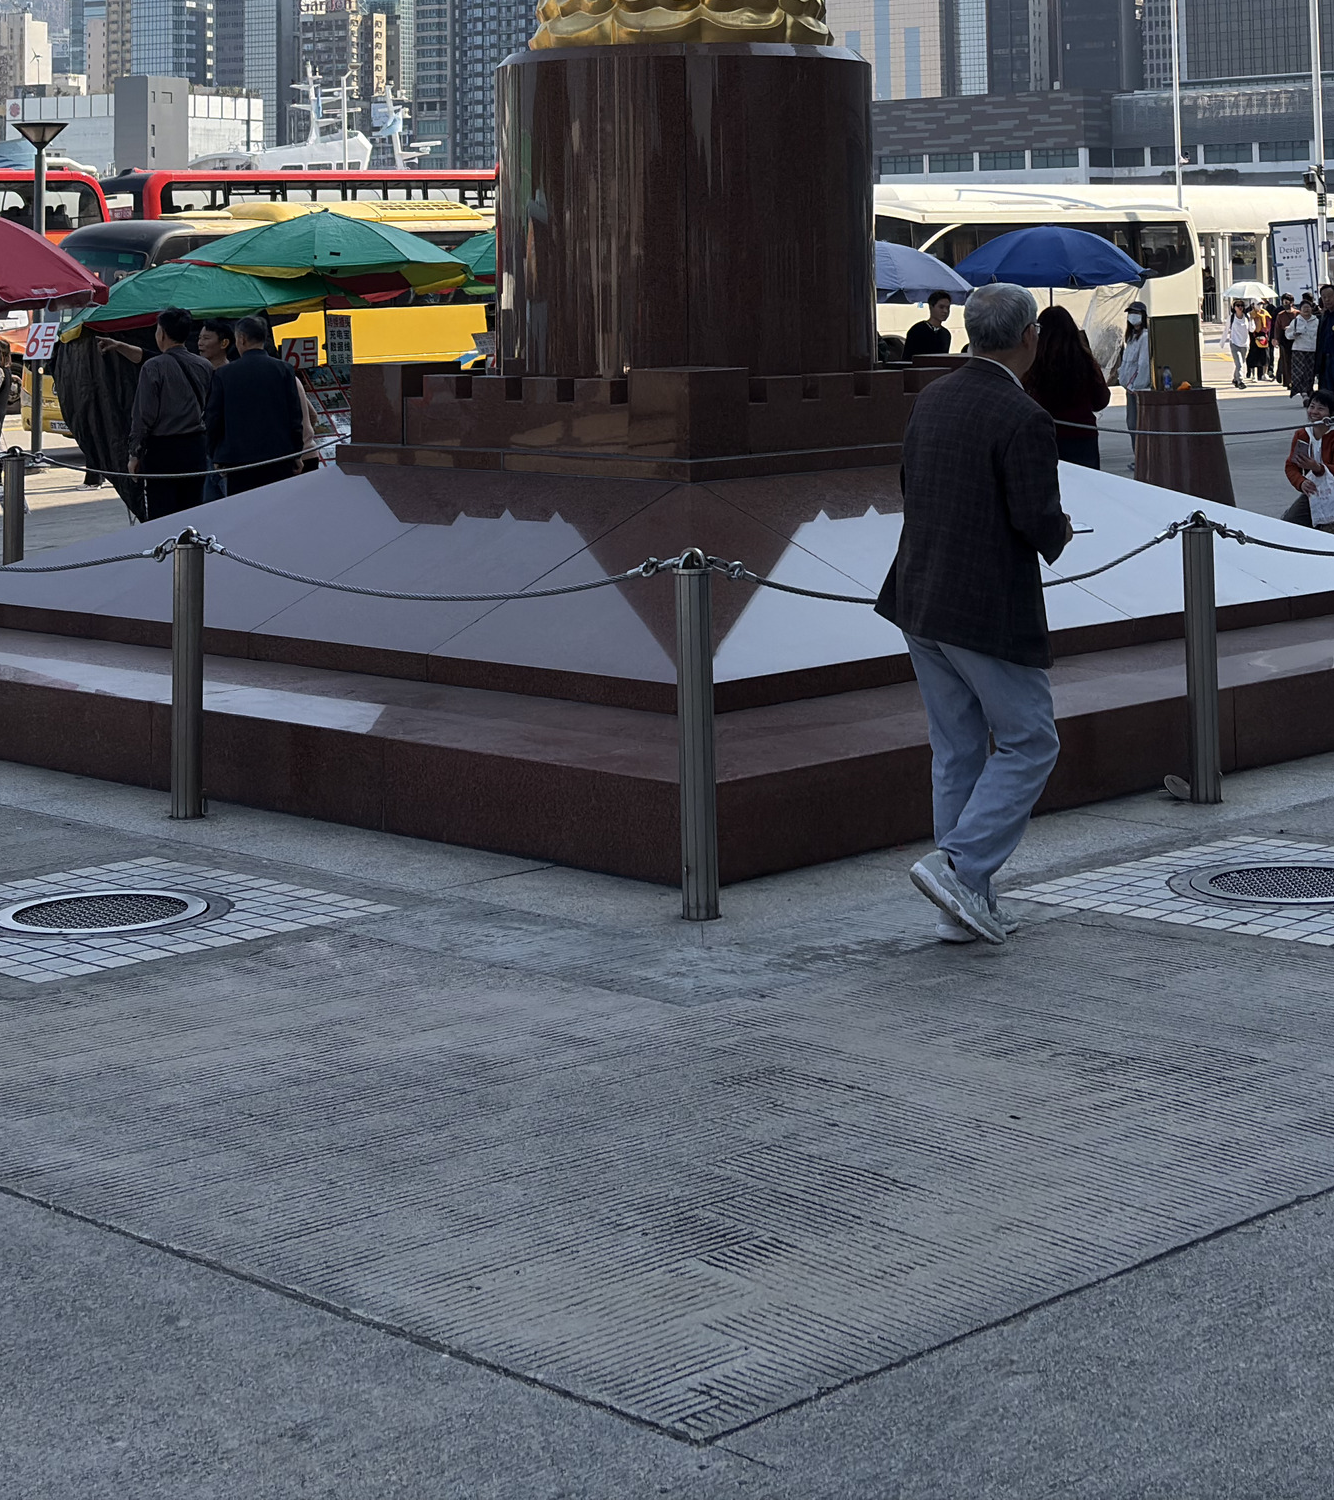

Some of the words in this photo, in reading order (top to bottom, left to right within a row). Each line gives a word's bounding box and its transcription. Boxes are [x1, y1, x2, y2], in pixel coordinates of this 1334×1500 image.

[1278, 245, 1305, 254] Design
[329, 330, 350, 340] 充电宝
[26, 325, 56, 357] 6号
[330, 342, 351, 352] 数据线
[285, 338, 318, 370] 6号
[330, 353, 352, 364] 电话卡
